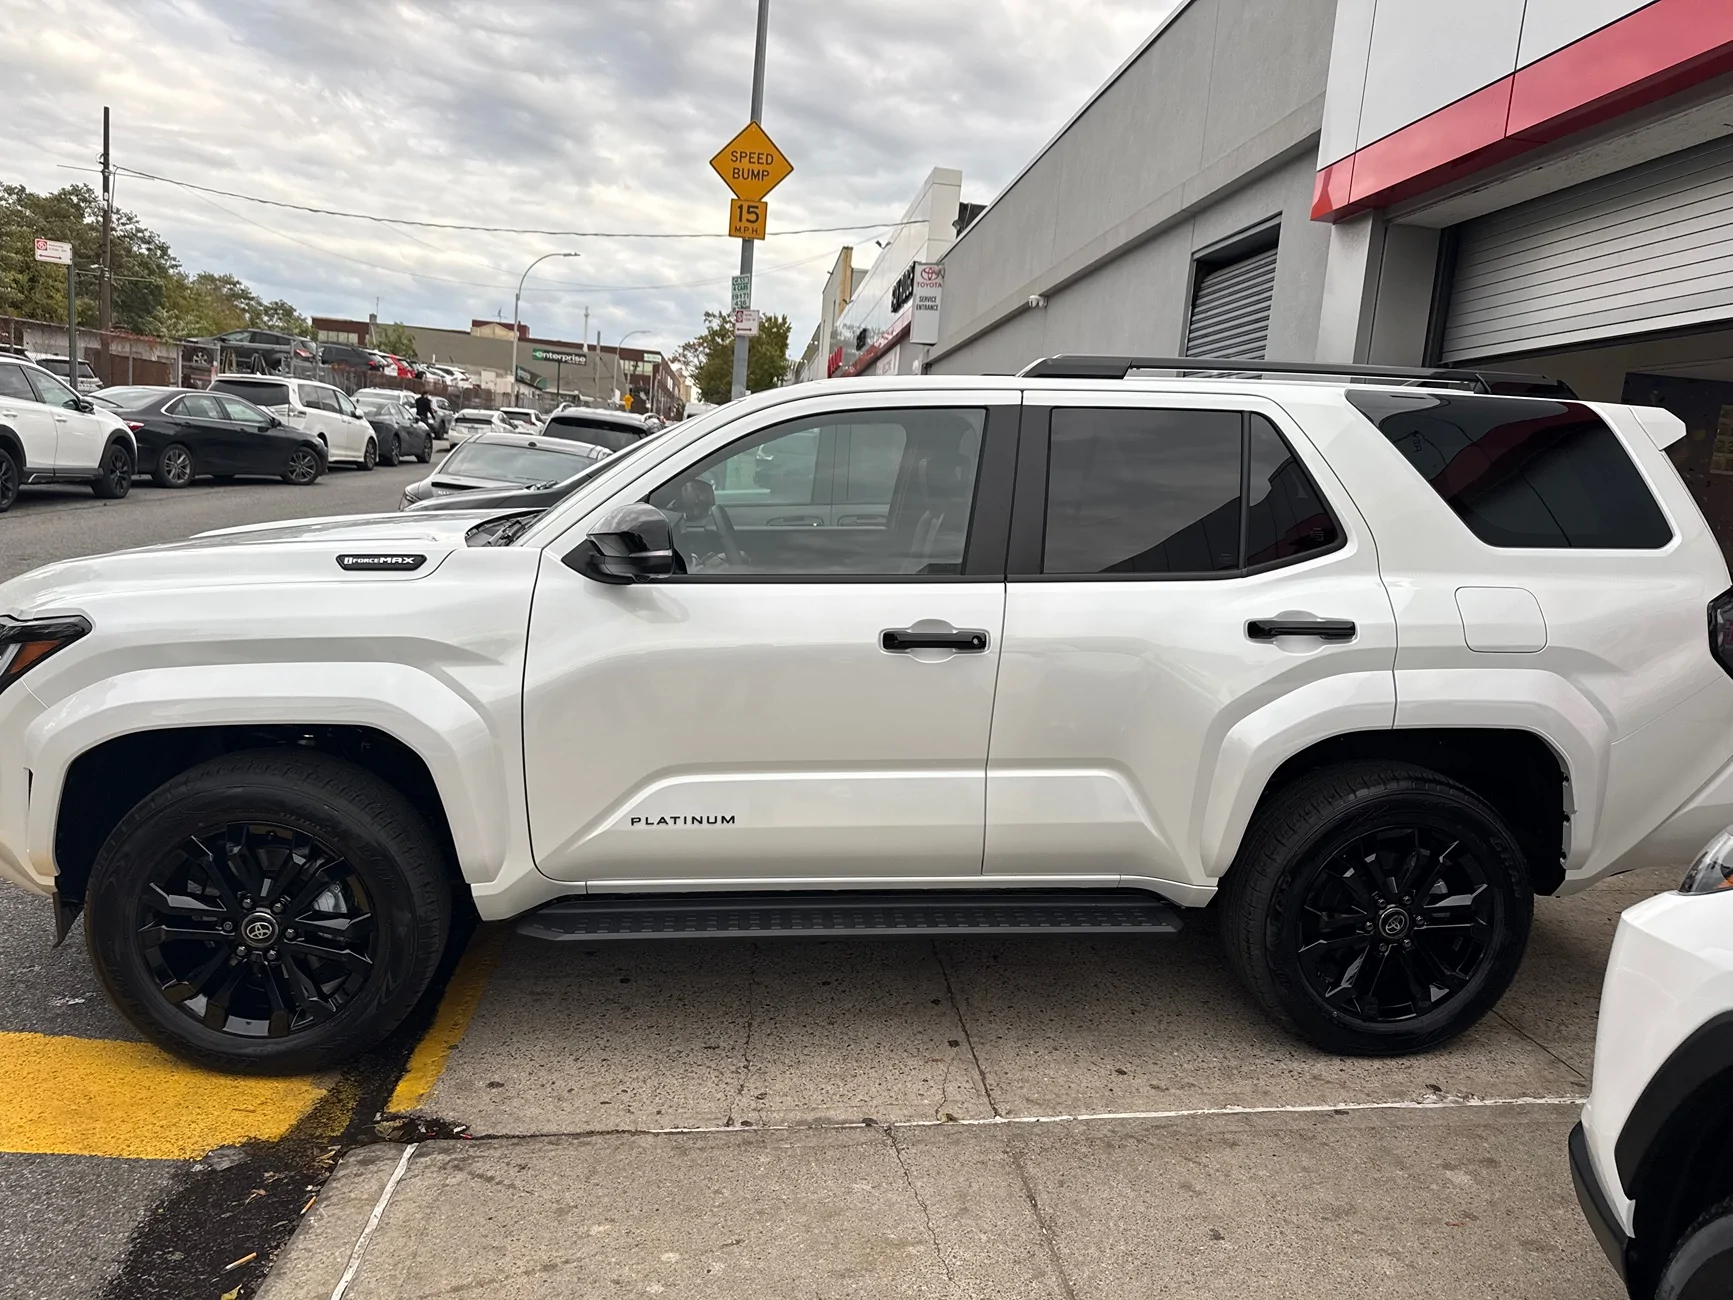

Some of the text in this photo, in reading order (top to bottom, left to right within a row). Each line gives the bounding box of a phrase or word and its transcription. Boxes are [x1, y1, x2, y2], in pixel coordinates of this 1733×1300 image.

[730, 150, 774, 166] SPEED
[732, 167, 770, 182] BUMP
[737, 203, 760, 224] 15
[916, 281, 942, 289] TOYOTA
[732, 292, 749, 301] (917)
[918, 295, 937, 303] SERVICE
[533, 350, 586, 362] enterprise
[630, 815, 736, 826] PLATINUM
